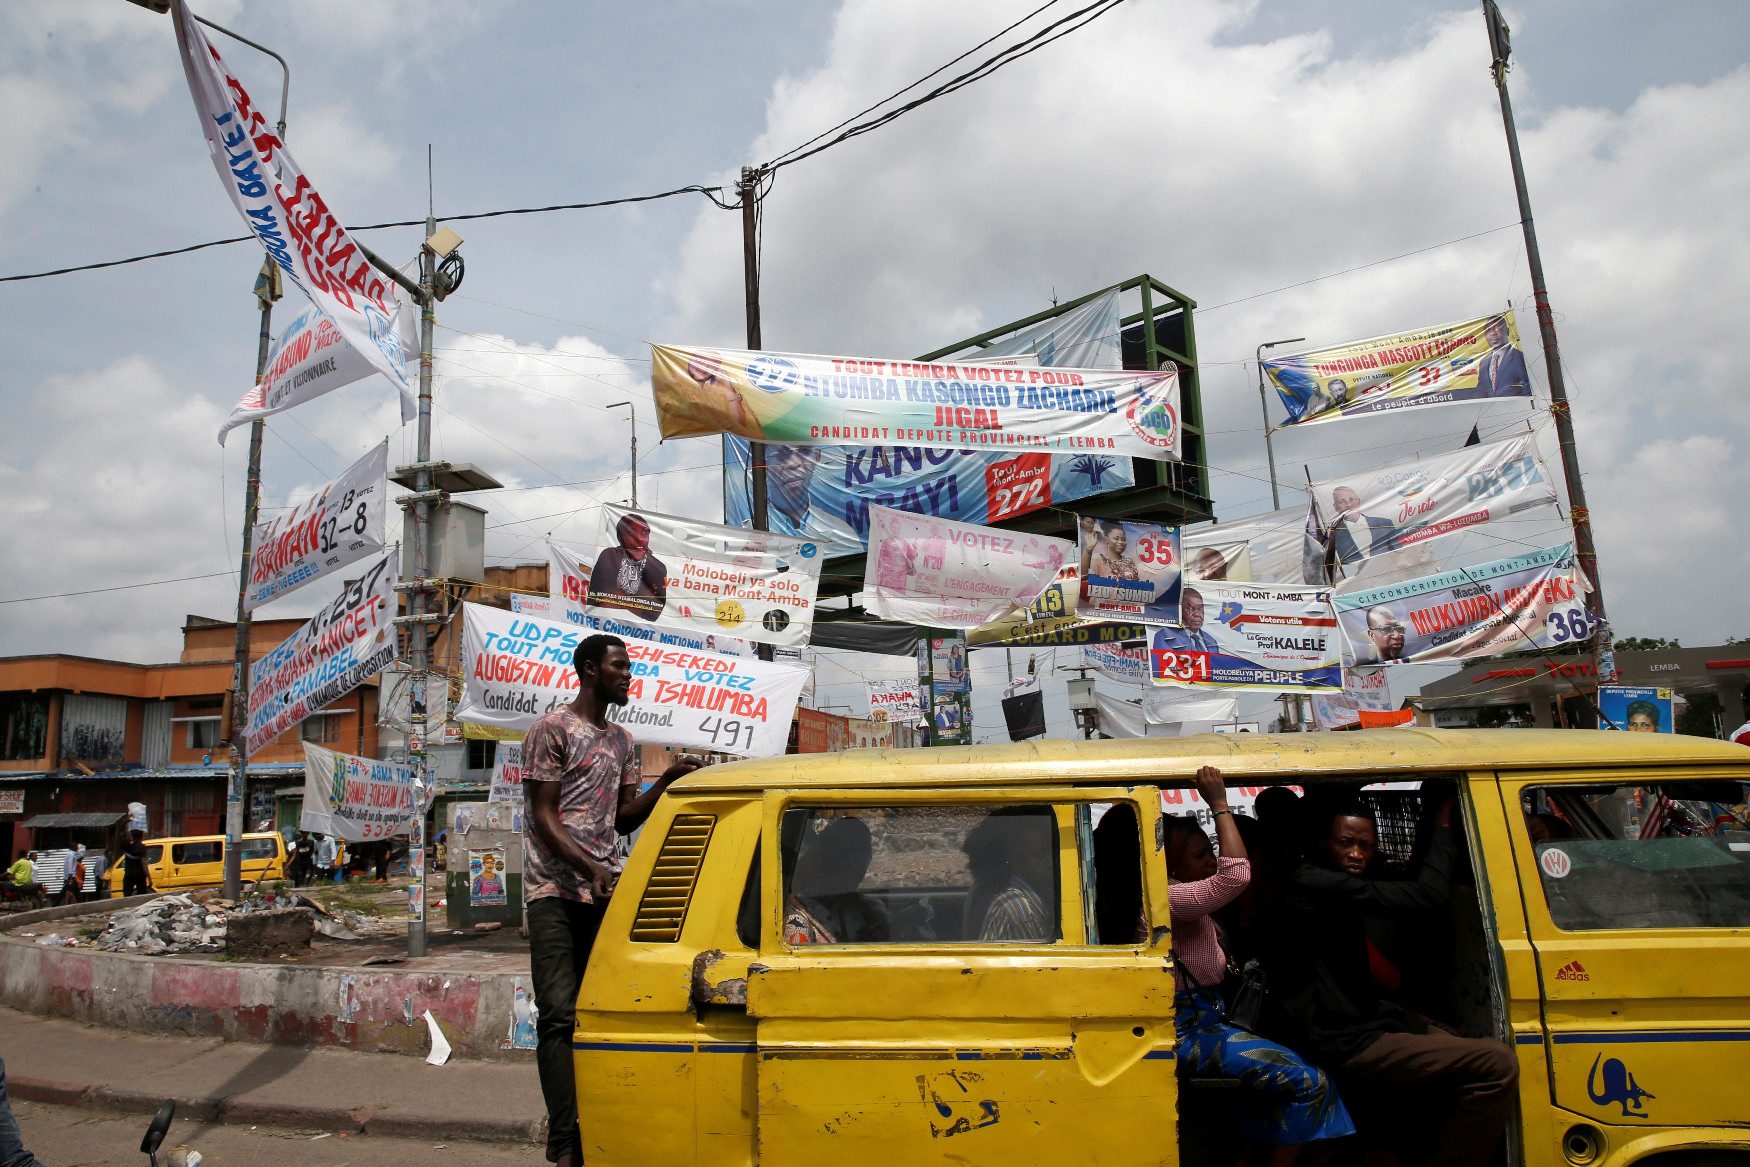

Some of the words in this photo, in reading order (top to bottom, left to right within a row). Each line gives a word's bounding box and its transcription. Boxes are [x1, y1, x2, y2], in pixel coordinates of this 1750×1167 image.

[1380, 343, 1433, 366] MASCOTY
[293, 356, 337, 389] VISIONNAIRE
[831, 360, 885, 376] TOUT
[891, 362, 958, 380] LEMBA
[963, 366, 1025, 383] VOTEZ
[1030, 371, 1084, 387] POUR
[804, 375, 901, 400] NTUMBA
[904, 378, 1010, 408] KASONGO
[1015, 386, 1118, 414] ZACHARIE
[934, 406, 1003, 430] JIGAL
[811, 425, 889, 440] CANDIDAT
[897, 428, 952, 442] DEPUTE
[960, 431, 1049, 447] PROVINCIAL
[1070, 437, 1115, 449] LEMBA
[340, 489, 355, 513] 13
[356, 485, 374, 498] VOTEZ
[995, 478, 1044, 517] 272
[1398, 500, 1415, 523] Je
[349, 540, 365, 552] VOTEZ
[948, 528, 1015, 555] VOTEZ
[1138, 538, 1172, 565] 35
[325, 556, 340, 567] VOTEZ
[330, 558, 389, 625] 237
[682, 563, 746, 585] Molobeli
[750, 576, 766, 588] ya
[770, 578, 800, 593] solo
[944, 577, 1011, 597] L'ENGAGEMENT
[1358, 574, 1466, 604] CIRCONSCRIPTION
[1472, 569, 1485, 579] DE
[1491, 554, 1554, 574] MONT-AMBA
[662, 576, 680, 589] ya
[683, 576, 719, 594] bana
[723, 584, 809, 609] Mont-Amba
[970, 599, 980, 607] ET
[1217, 589, 1241, 598] TOUT
[1243, 590, 1270, 601] MONT
[1277, 593, 1304, 602] AMBA
[719, 612, 741, 623] 214
[1099, 603, 1141, 612] MONT-AMBA
[1259, 615, 1283, 625] Votons
[1285, 617, 1303, 625] utile
[1409, 592, 1501, 637] MUKUMBU
[320, 594, 381, 661] ANICET
[509, 619, 578, 648] UDPS
[566, 609, 600, 631] NOTRE
[603, 619, 656, 640] CANDIDAT
[660, 632, 705, 650] NATIONAL
[1011, 621, 1046, 637] C'est
[1431, 630, 1467, 646] Candidat
[1258, 641, 1273, 649] Prof
[1275, 637, 1326, 652] KALELE
[289, 646, 358, 704] PAMABEL
[485, 632, 538, 659] TOUT
[684, 669, 756, 692] VOTEZ
[1163, 651, 1208, 681] 231
[1650, 663, 1680, 672] LEMBA
[306, 679, 343, 712] DYNAMIQUE
[340, 674, 351, 691] DE
[349, 643, 394, 689] L'OPPOSITION
[473, 653, 553, 690] AUGUSTIN
[655, 679, 768, 723] TSHILUMBA
[1254, 671, 1304, 683] PEUPLE
[484, 688, 539, 716] Candidat
[606, 702, 675, 728] National
[698, 716, 755, 750] 491
